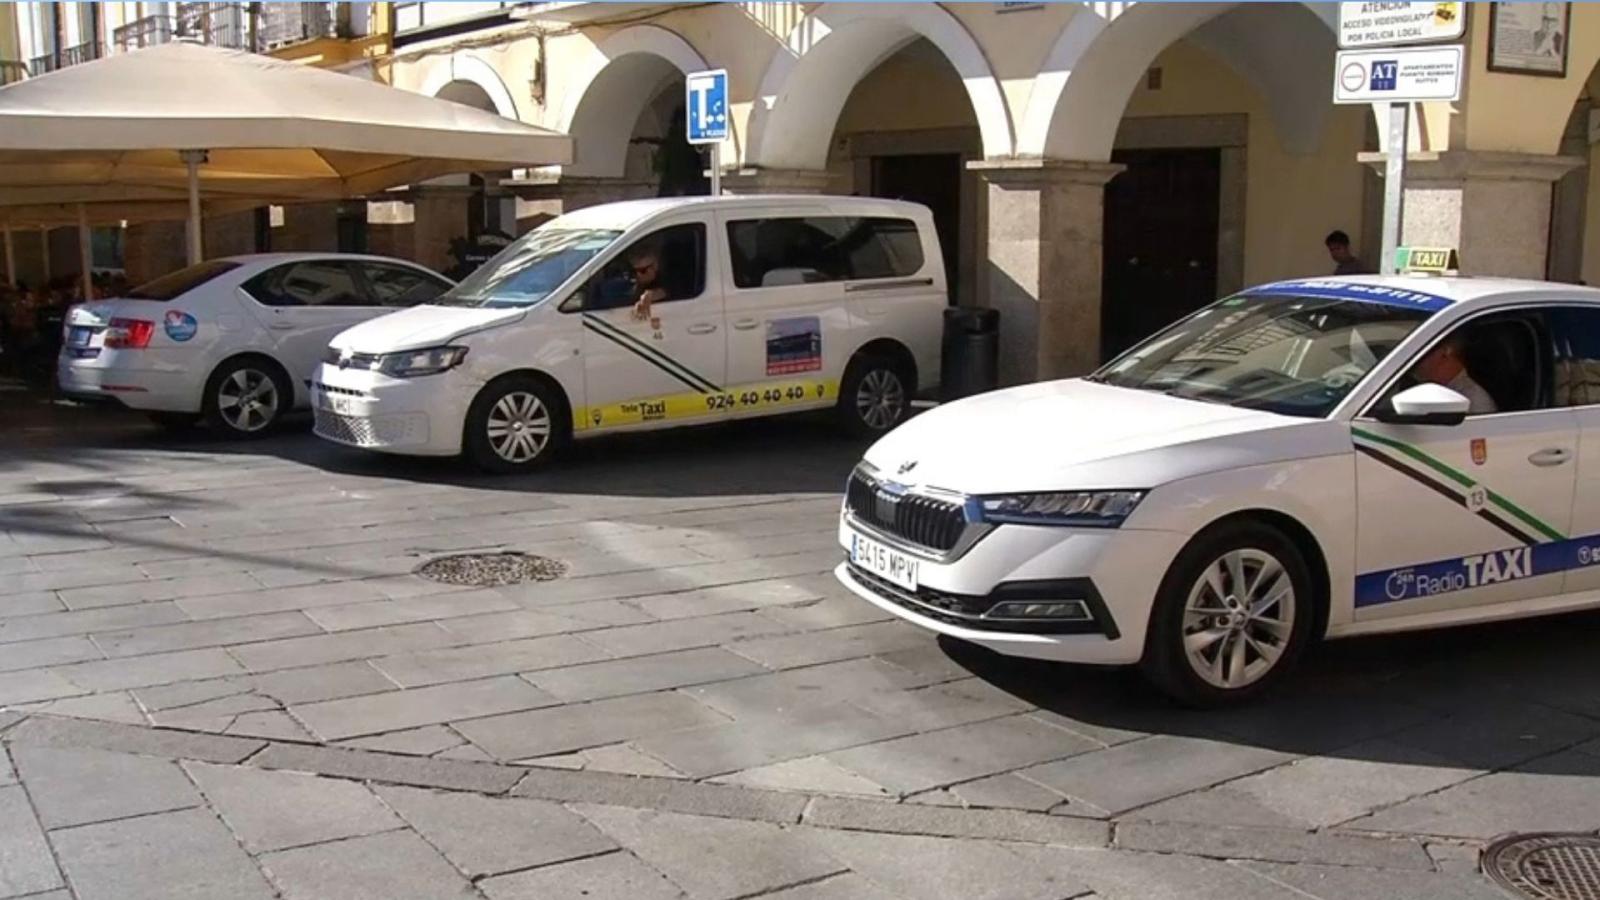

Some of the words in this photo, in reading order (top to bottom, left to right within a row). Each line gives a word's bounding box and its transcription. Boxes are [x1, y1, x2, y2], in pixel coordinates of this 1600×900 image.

[1343, 18, 1372, 29] ACCESO
[1347, 34, 1363, 42] POR
[1365, 30, 1394, 41] POLICIA
[1397, 28, 1423, 38] LOCAL
[1372, 63, 1397, 79] AT
[1416, 252, 1445, 266] TAXI
[620, 403, 638, 414] Tele
[639, 399, 665, 416] Taxi
[706, 395, 735, 411] 924
[740, 391, 759, 405] 40
[763, 388, 782, 403] 40
[786, 386, 804, 400] 40
[1471, 491, 1484, 506] 13
[858, 539, 886, 572] 5415
[890, 553, 916, 584] MPV
